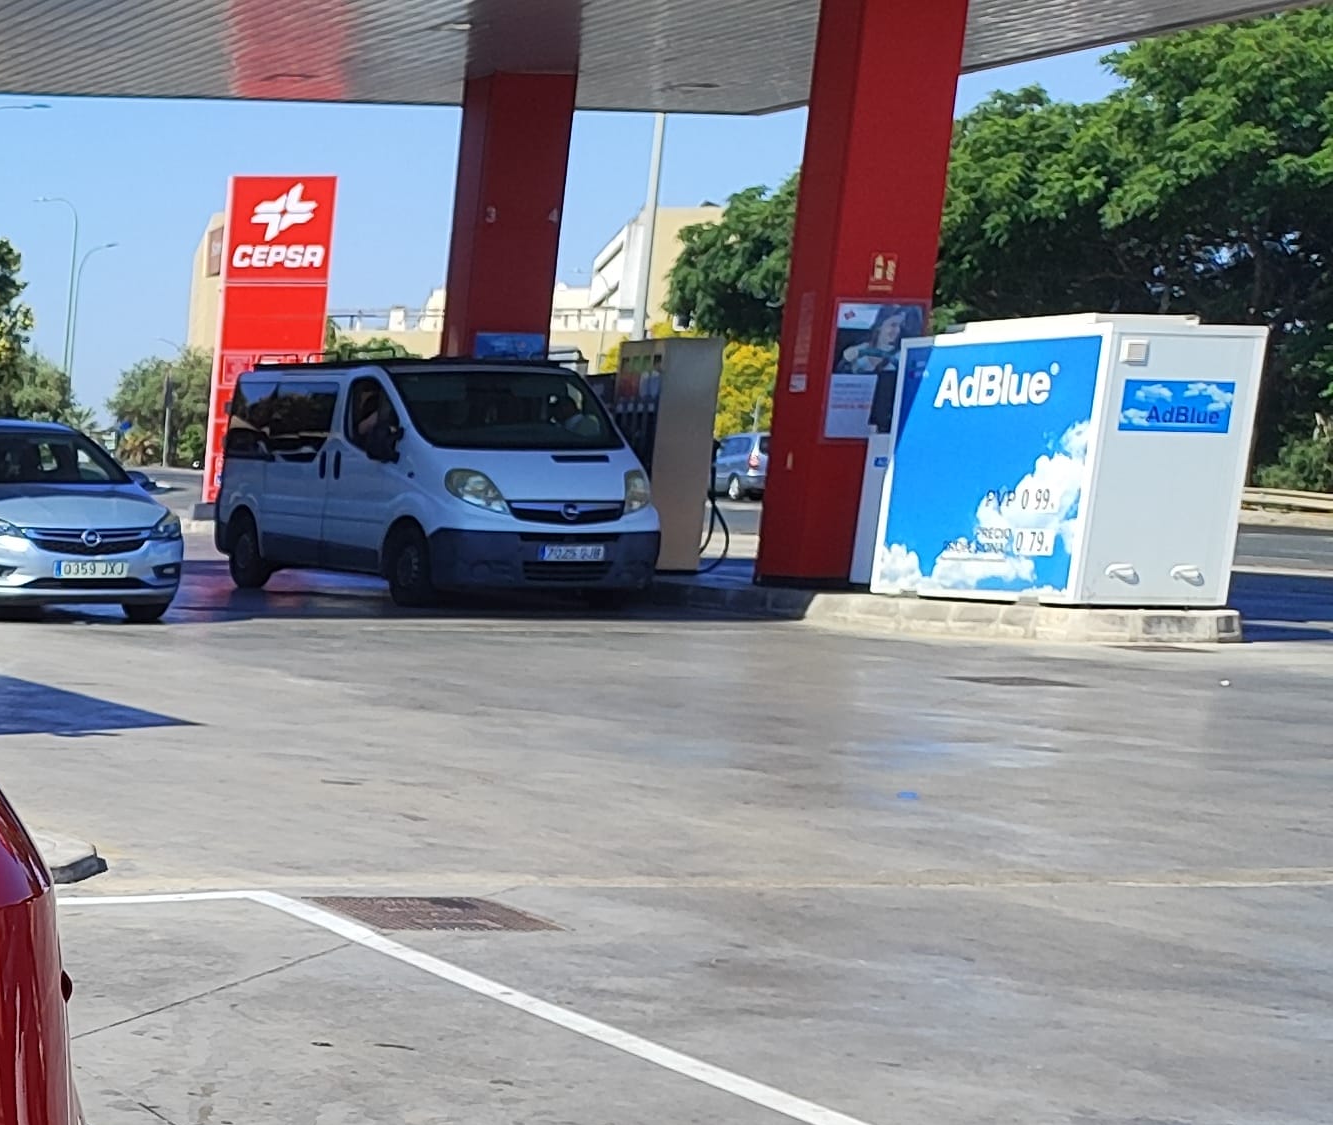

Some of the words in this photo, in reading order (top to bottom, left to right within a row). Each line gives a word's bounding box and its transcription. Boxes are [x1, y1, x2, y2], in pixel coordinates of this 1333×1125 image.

[232, 244, 326, 268] CEPSA
[1145, 405, 1221, 426] AdBlue
[985, 489, 1017, 507] PVP
